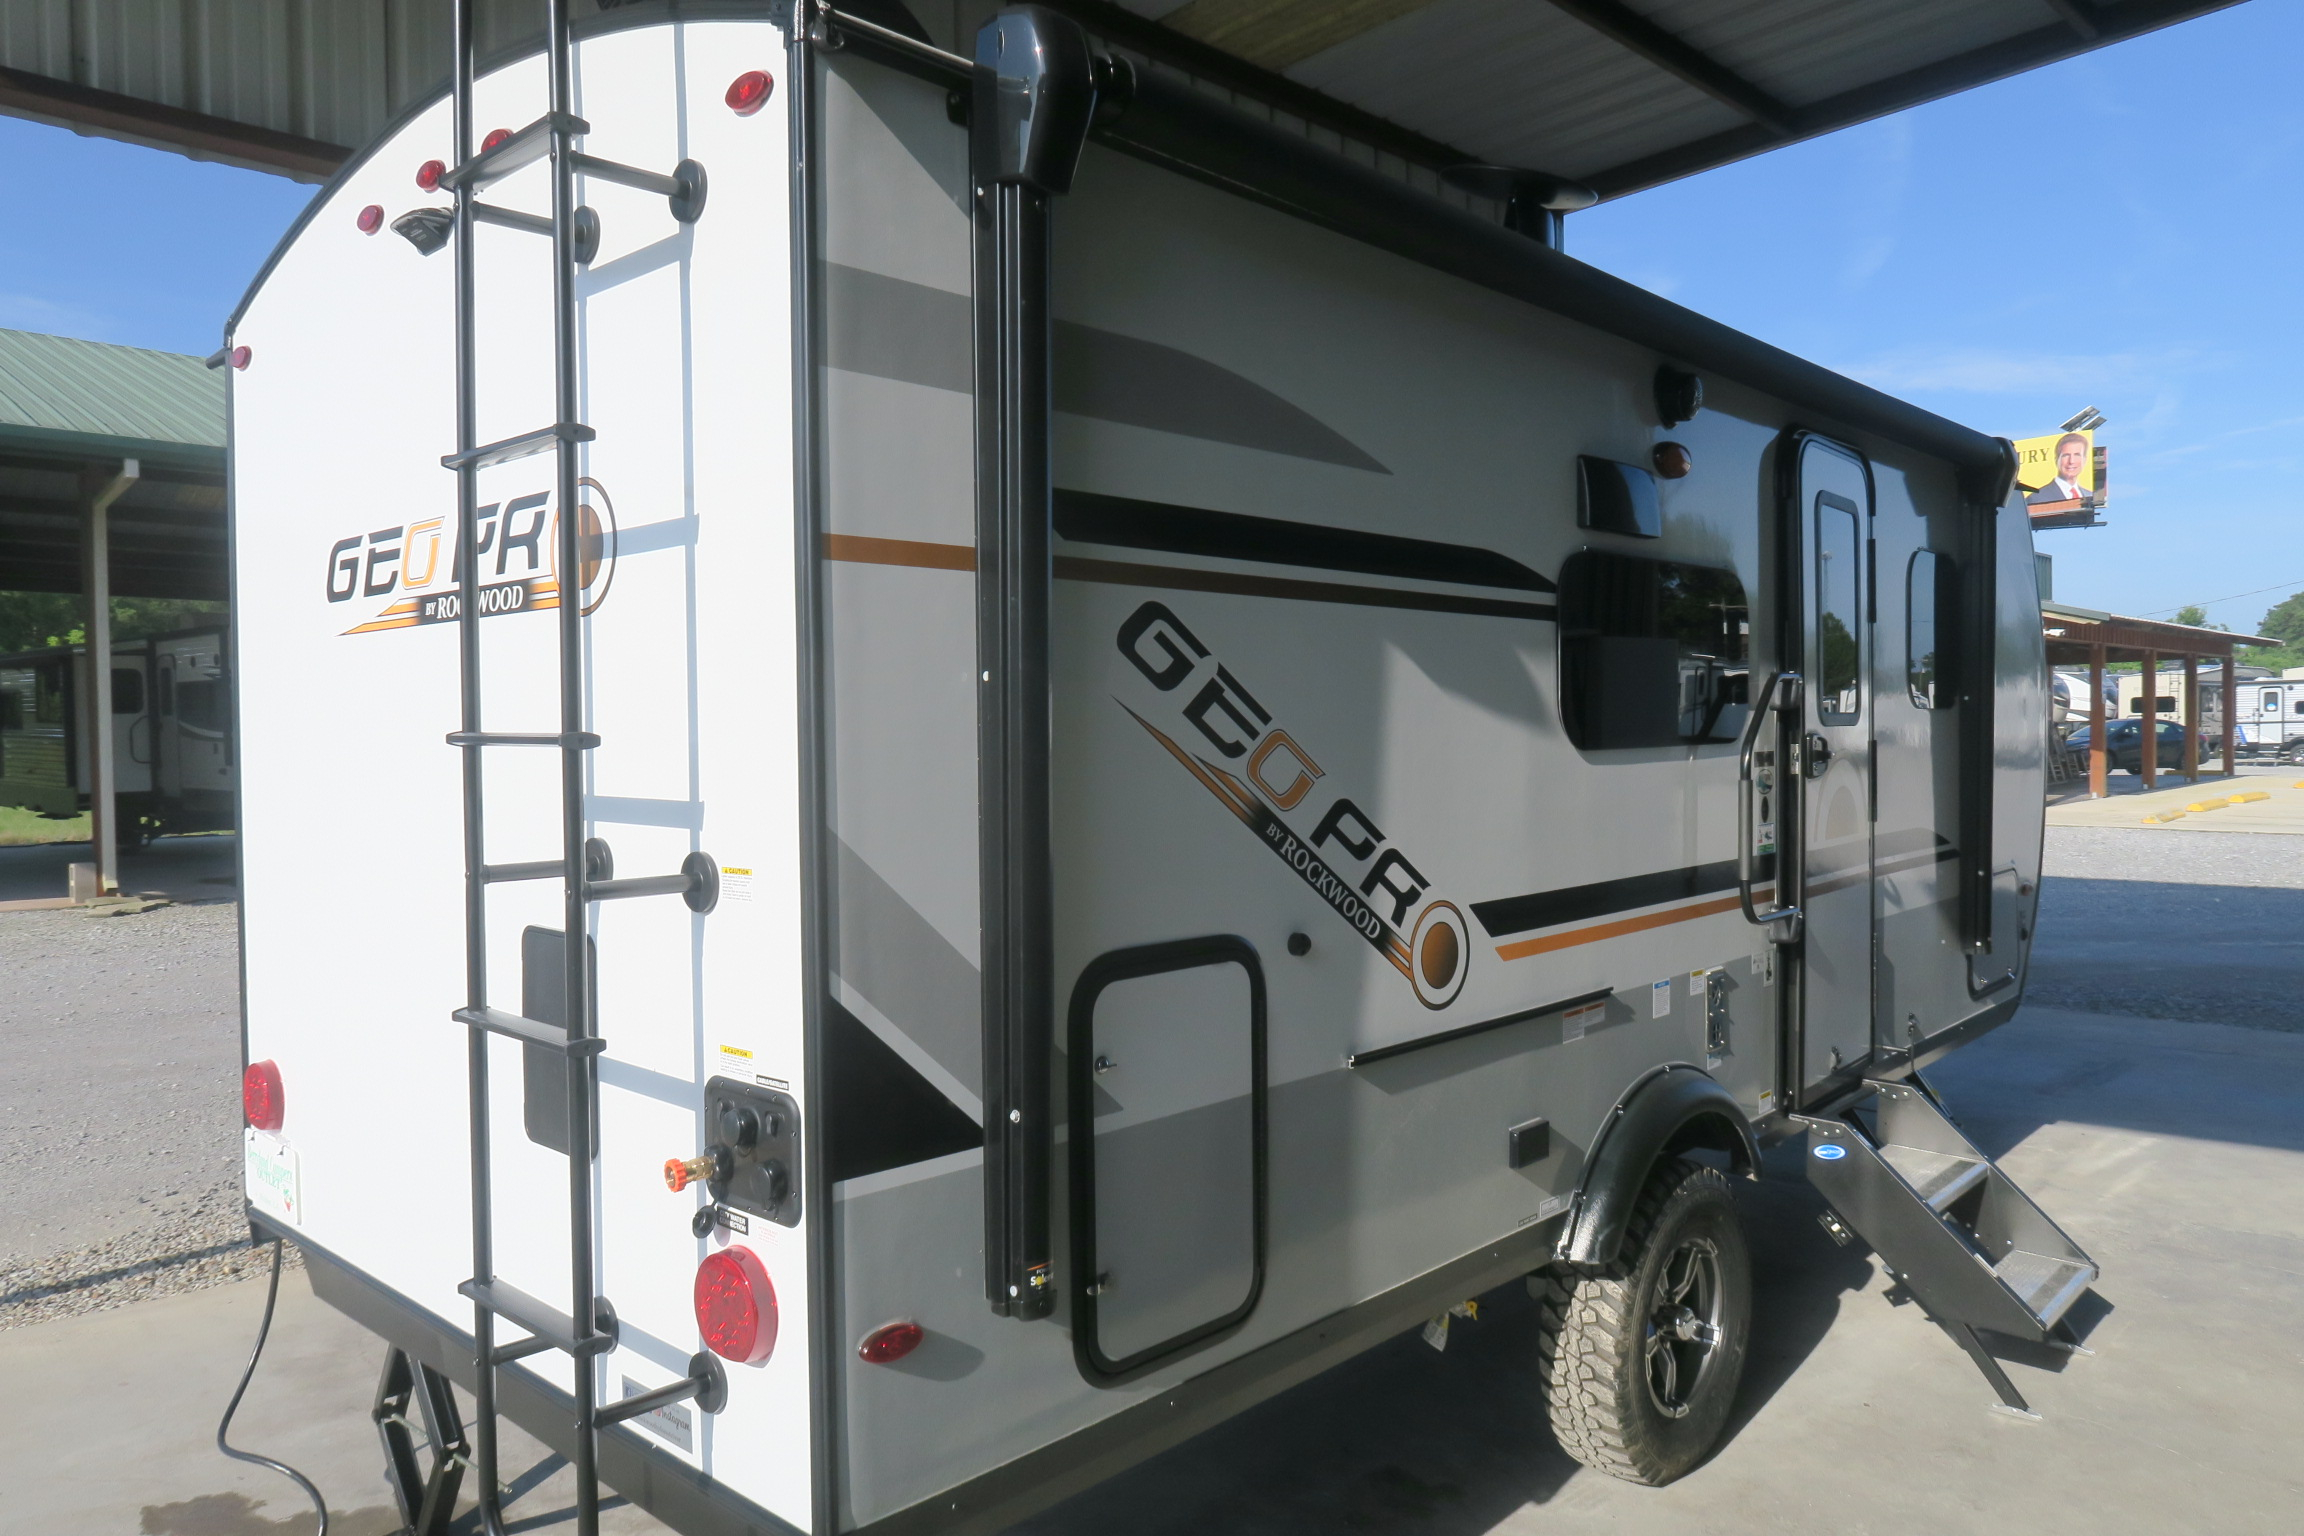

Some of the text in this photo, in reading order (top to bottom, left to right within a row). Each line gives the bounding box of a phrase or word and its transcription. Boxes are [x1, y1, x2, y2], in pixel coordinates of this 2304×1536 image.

[326, 515, 446, 604] GEO
[425, 585, 524, 619] BY ROWOOD
[1116, 600, 1326, 812] GEO
[729, 867, 749, 875] CAUTION
[1266, 822, 1381, 940] BY ROCKWOOD
[727, 1047, 748, 1058] CAUTION
